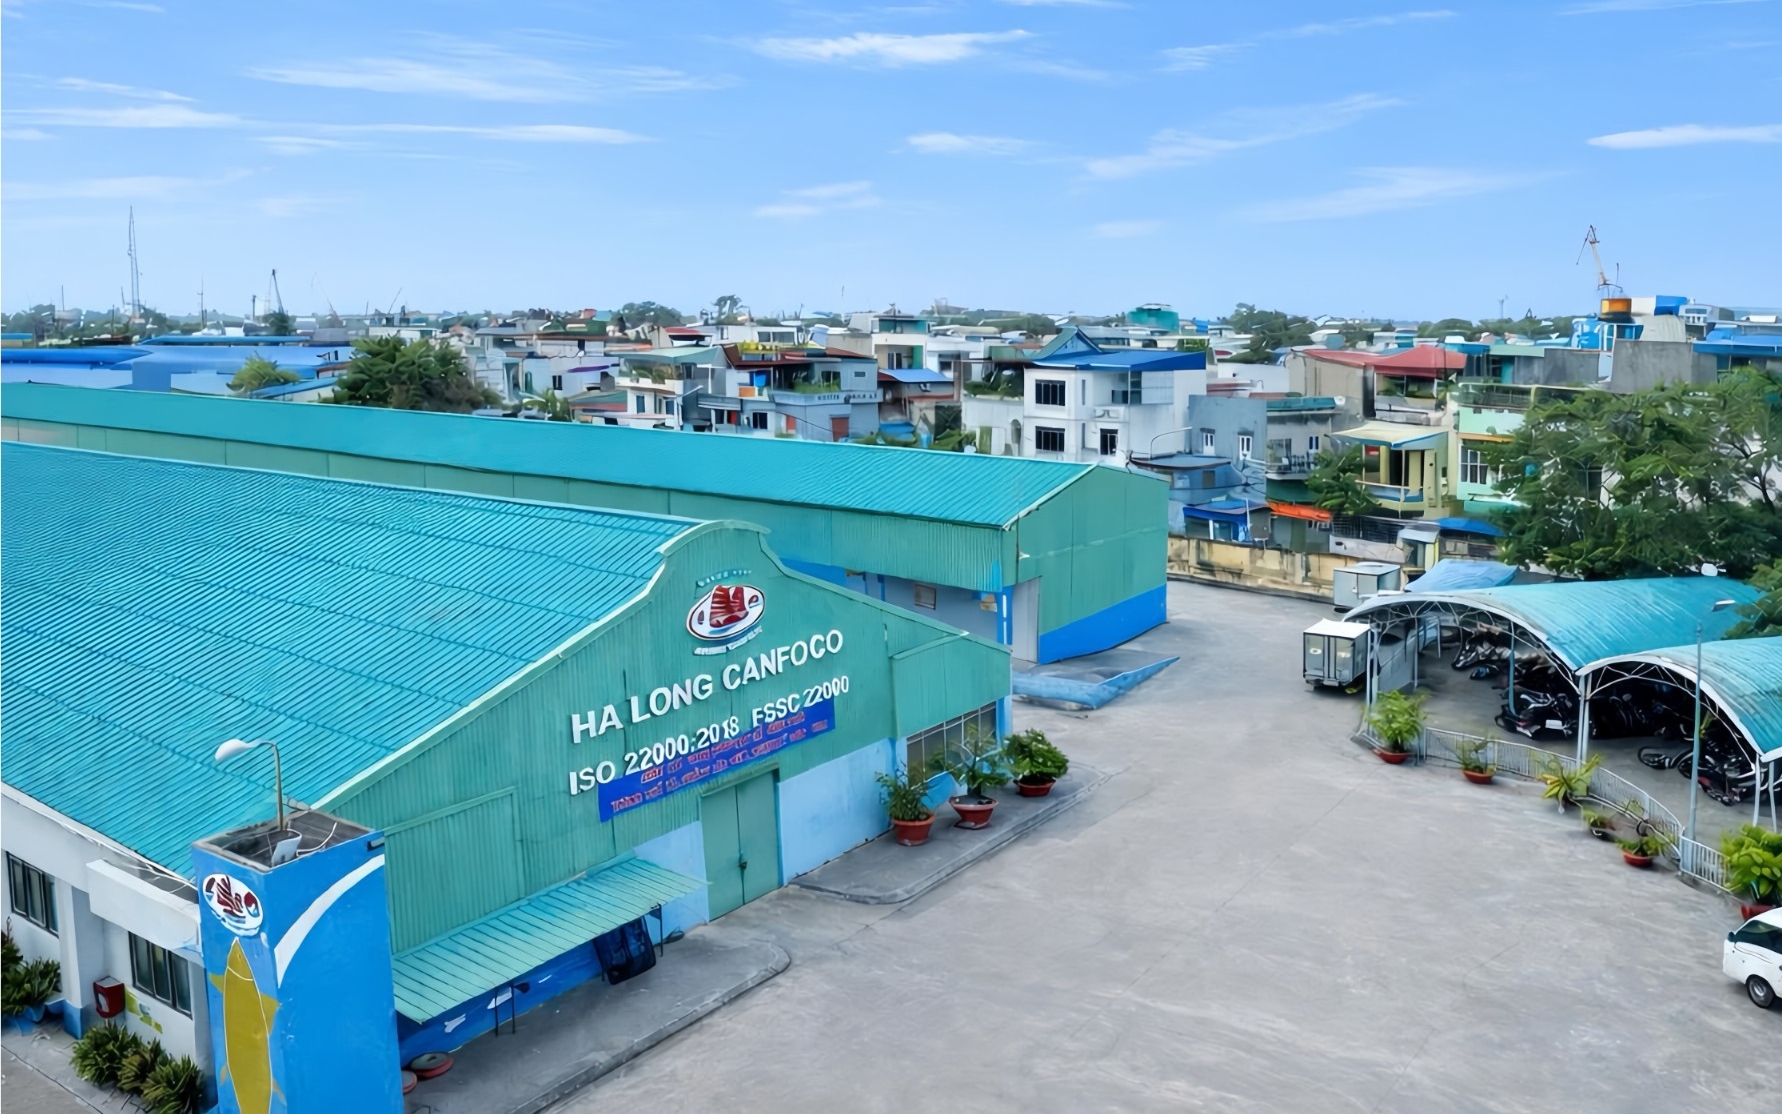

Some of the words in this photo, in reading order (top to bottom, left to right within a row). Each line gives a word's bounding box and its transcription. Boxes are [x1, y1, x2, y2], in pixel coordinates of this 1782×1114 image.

[569, 760, 616, 795] ISO
[752, 694, 801, 728] FSSC
[803, 676, 849, 708] 22000
[571, 704, 625, 744] HA
[630, 674, 713, 723] LONG
[722, 629, 843, 690] CANFOCO
